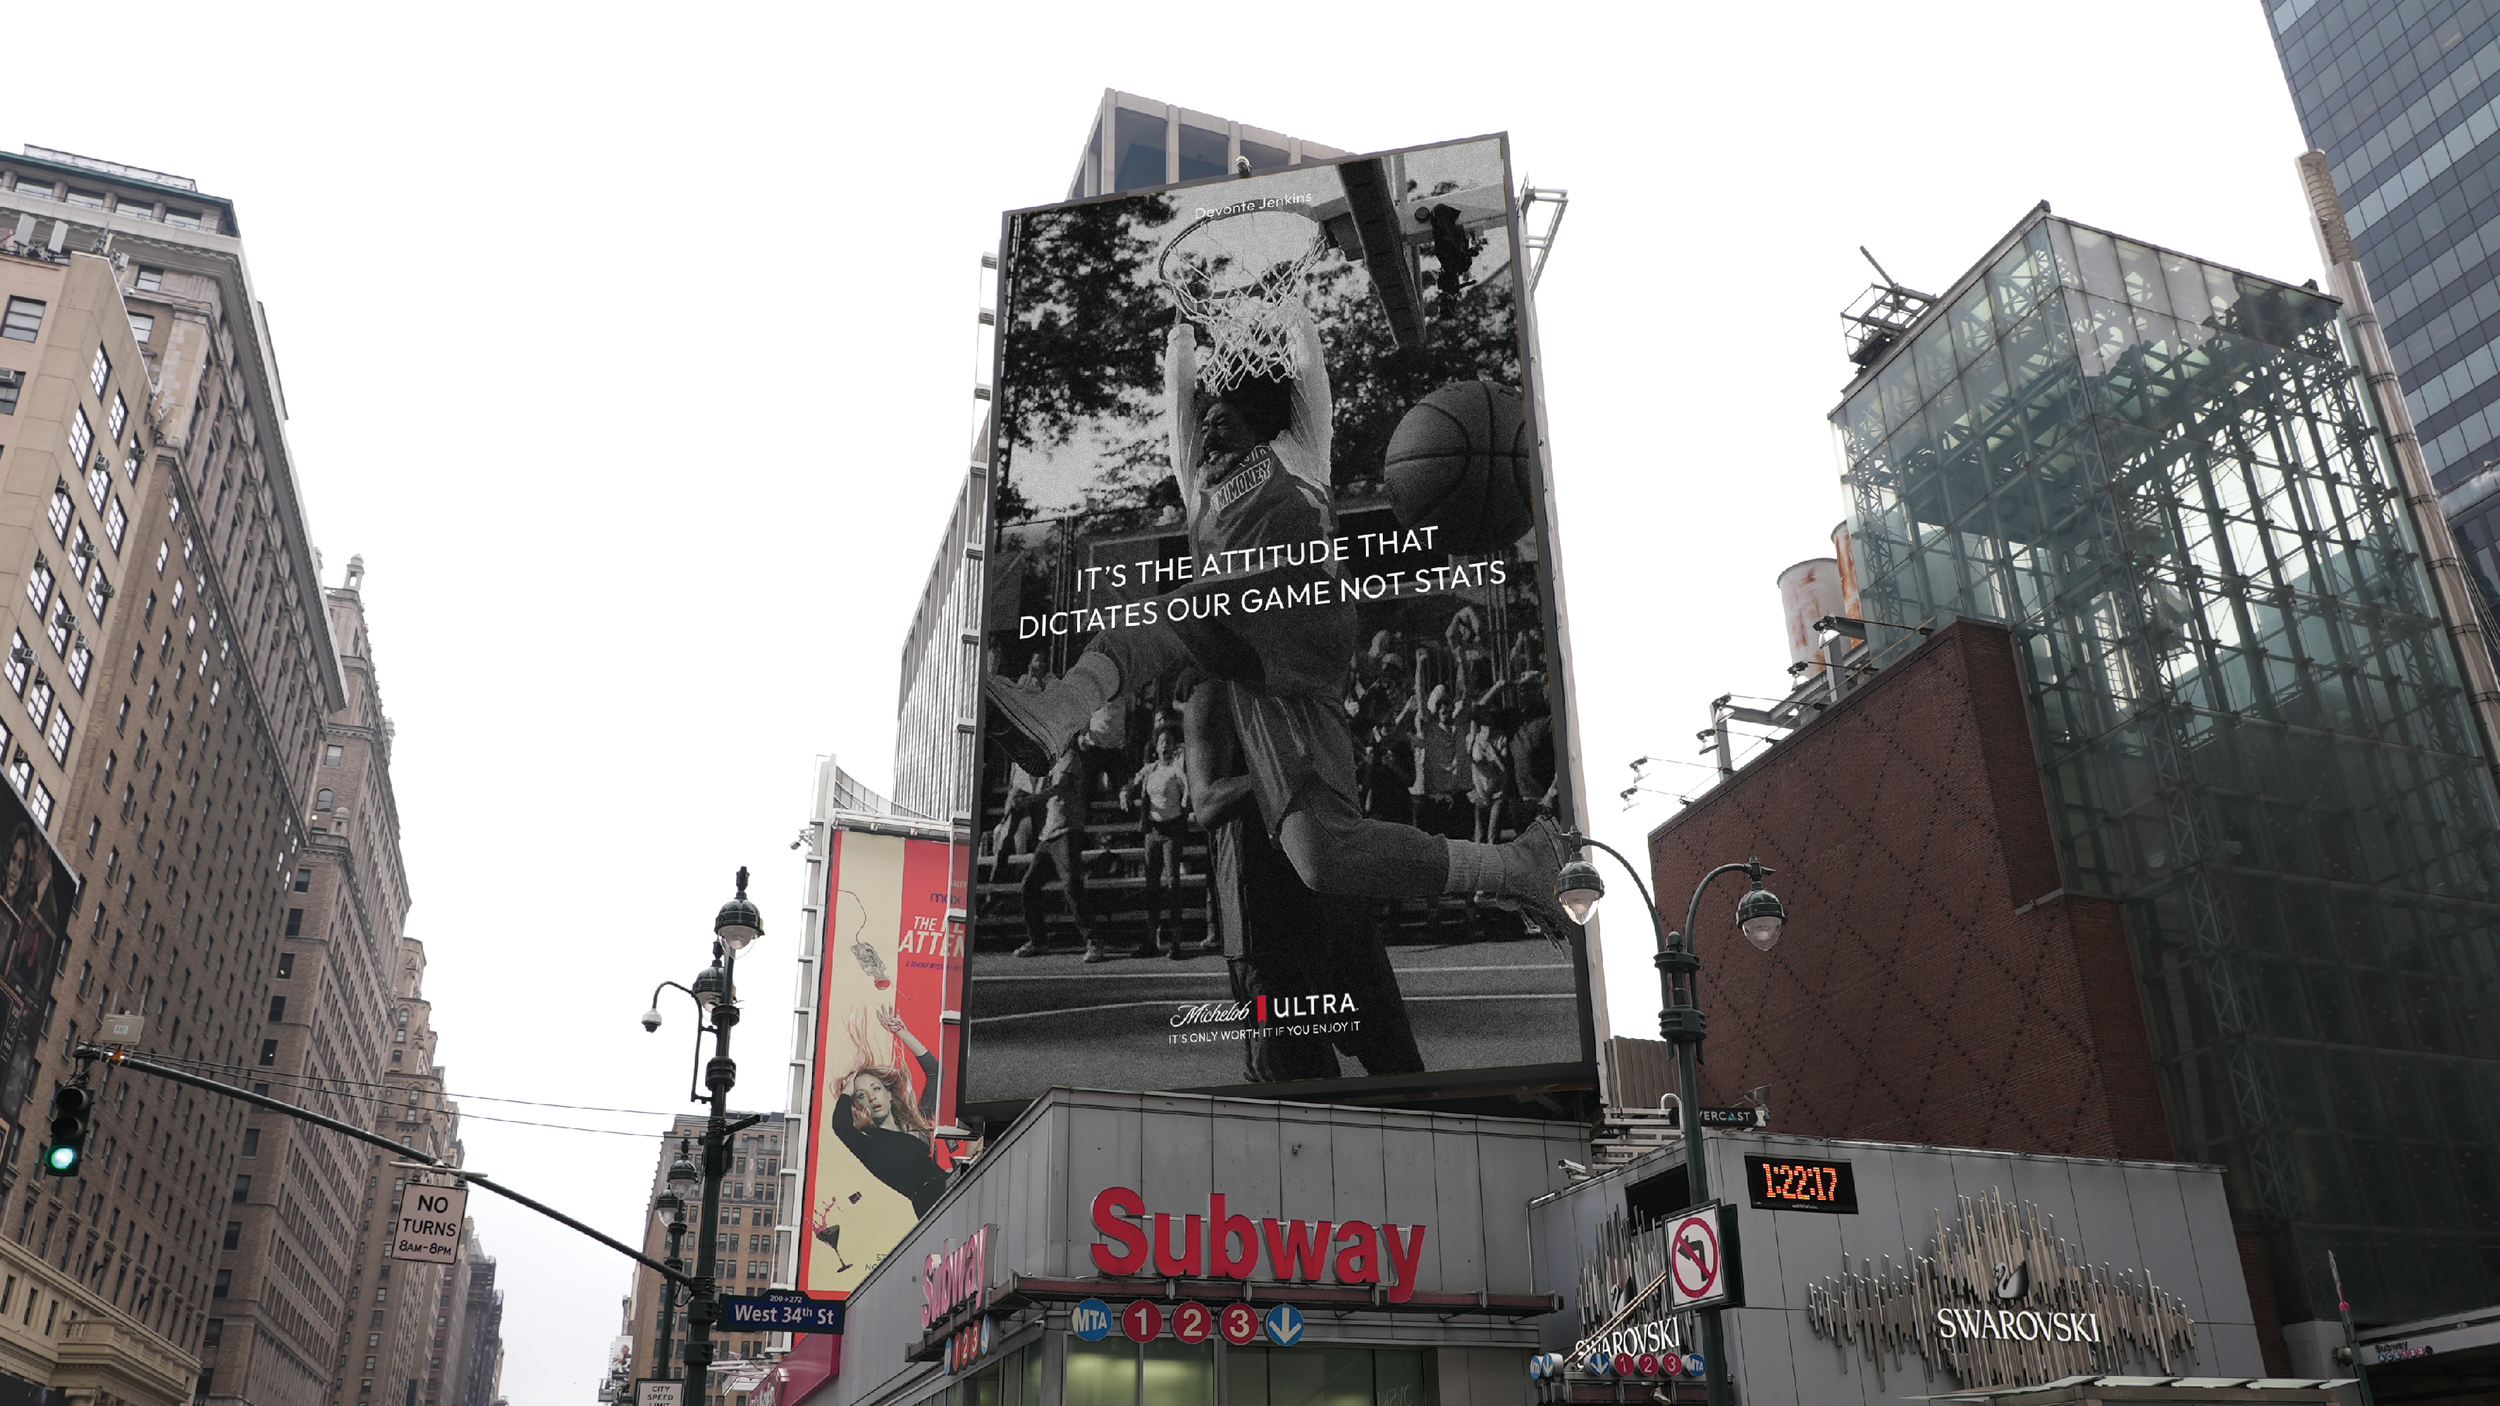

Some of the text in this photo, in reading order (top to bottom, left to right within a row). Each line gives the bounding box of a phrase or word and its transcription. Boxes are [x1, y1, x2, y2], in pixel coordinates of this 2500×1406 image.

[1195, 193, 1312, 219] Devonte Jenkins
[1135, 556, 1193, 584] THE
[1201, 536, 1349, 577] ATTITUDE
[1358, 525, 1438, 557] THAT
[1019, 560, 1507, 639] DICTATES OUR GAME NOT STATS
[914, 916, 938, 931] THE
[1170, 993, 1356, 1027] Michelob ULTRA
[1190, 1031, 1218, 1042] ONLY
[1222, 1028, 1260, 1041] WORTH
[1263, 1027, 1273, 1038] IT
[1276, 1026, 1285, 1036] IF
[1287, 1024, 1310, 1036] YOU
[1313, 1022, 1349, 1034] ENJOY
[1351, 1021, 1361, 1032] IT
[1762, 1163, 1838, 1201] 1:22:17
[417, 1194, 448, 1213] NO
[403, 1218, 456, 1237] TURNS
[399, 1240, 451, 1256] 8AM-8PM
[1090, 1186, 1427, 1303] Subway
[922, 1223, 990, 1329] Subway
[769, 1294, 803, 1304] 200 272
[734, 1304, 834, 1325] West 34th St
[1072, 1307, 1250, 1337] MTA 1 2 3
[1937, 1307, 2101, 1342] SWAROVSKI
[2375, 1341, 2408, 1353] Subway
[1644, 1356, 1653, 1373] 2
[1667, 1356, 1677, 1371] 3
[1686, 1358, 1704, 1372] MTA
